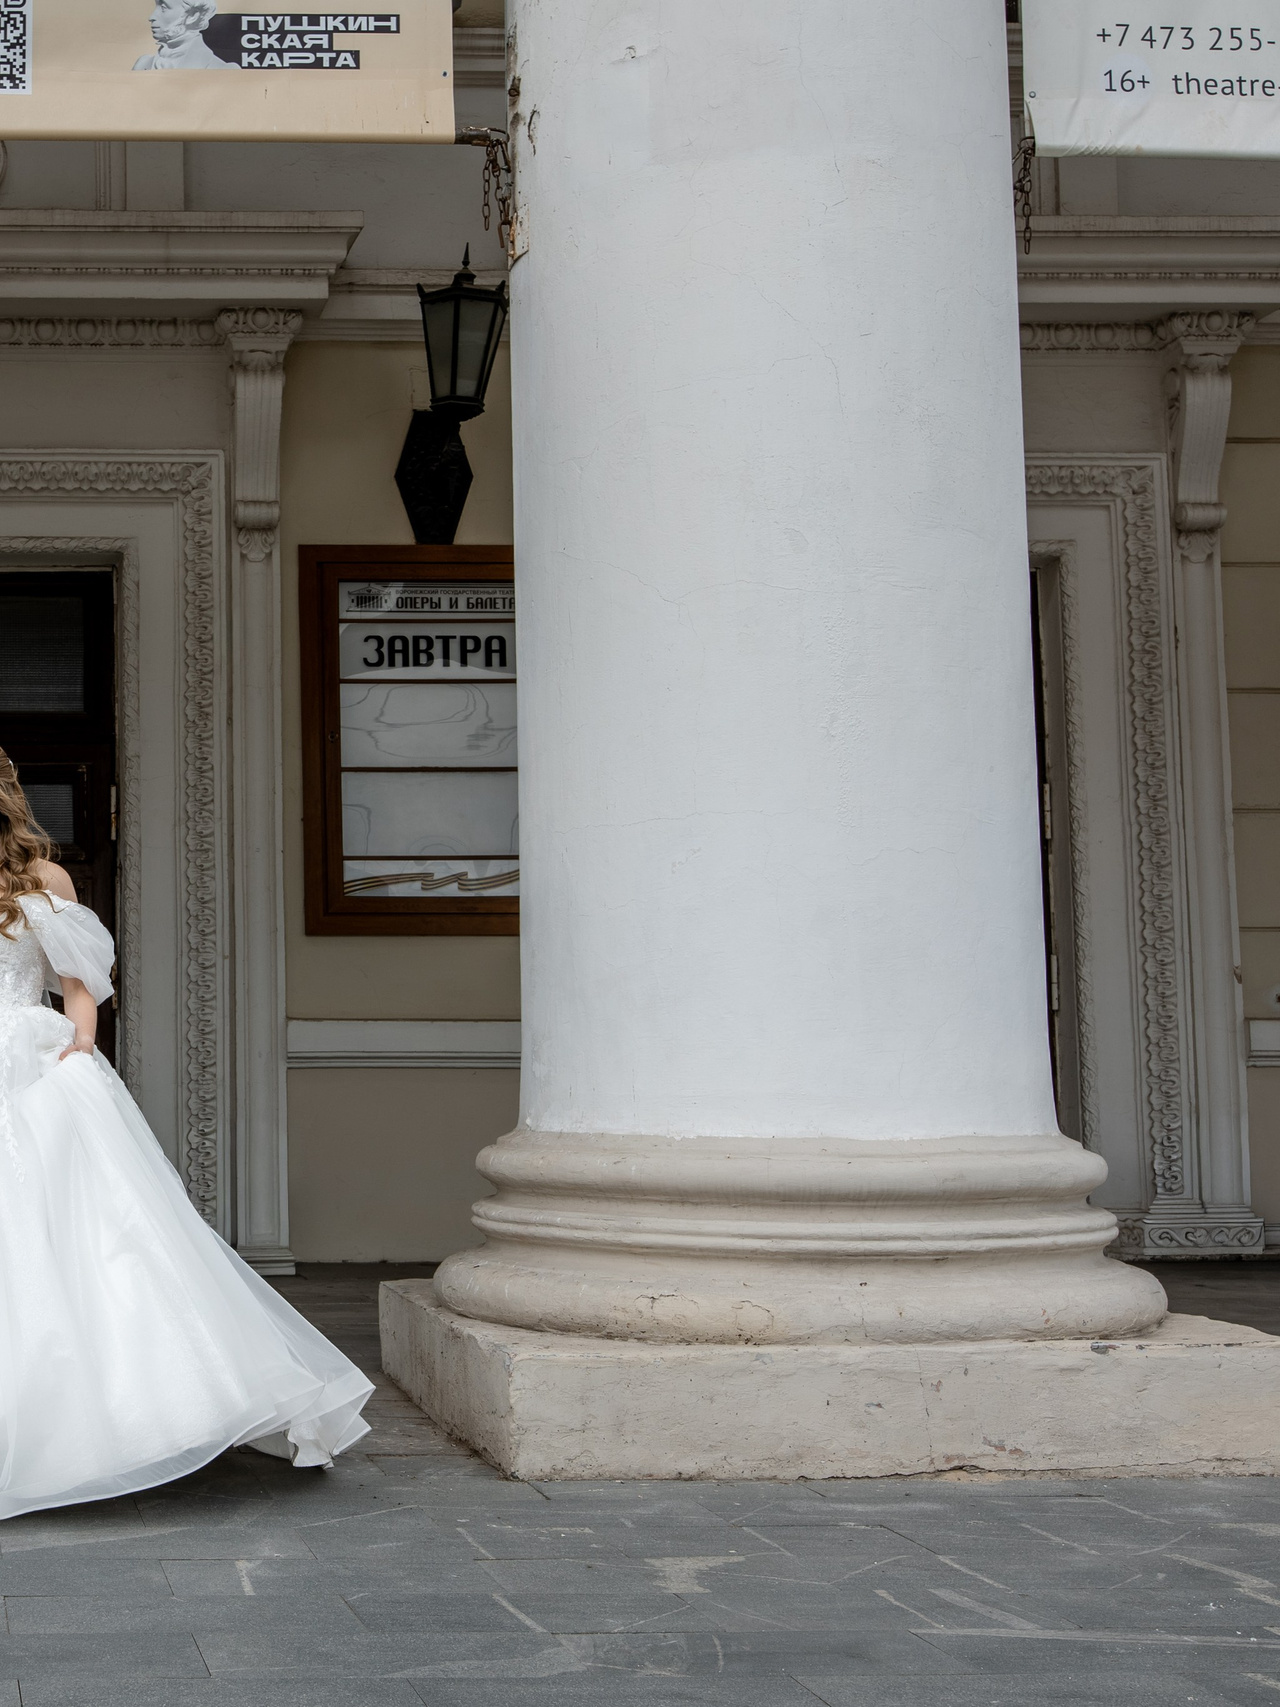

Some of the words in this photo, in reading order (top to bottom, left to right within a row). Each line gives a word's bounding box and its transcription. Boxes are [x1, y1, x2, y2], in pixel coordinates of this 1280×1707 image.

[241, 16, 397, 31] ПУШКИН
[240, 33, 329, 49] СКАЯ
[1096, 23, 1130, 47] +7
[1141, 25, 1195, 50] 473
[241, 52, 357, 68] КАРТА
[1103, 69, 1150, 93] 16+
[1172, 72, 1280, 97] theatre
[396, 596, 441, 610] ОПЕРЫ
[449, 597, 458, 610] И
[362, 635, 507, 668] ЗАВТРА
